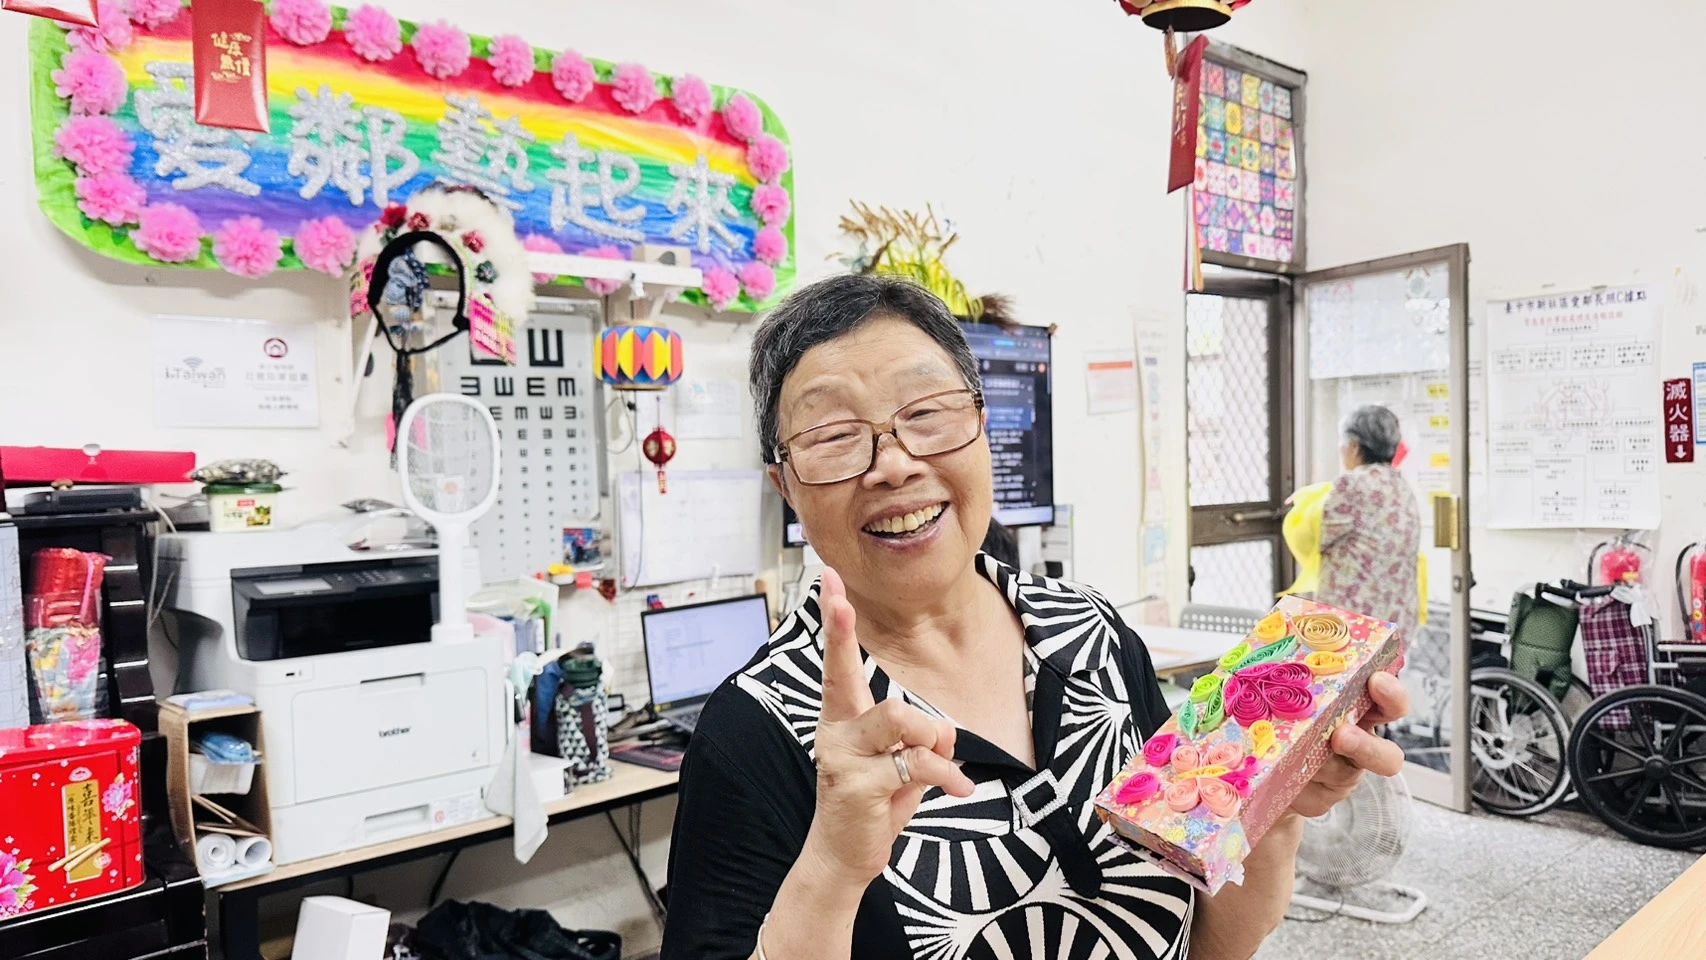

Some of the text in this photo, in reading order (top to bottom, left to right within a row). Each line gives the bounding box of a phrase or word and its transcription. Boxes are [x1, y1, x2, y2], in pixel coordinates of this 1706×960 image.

[1666, 381, 1690, 442] 滅火器
[379, 726, 411, 738] brother
